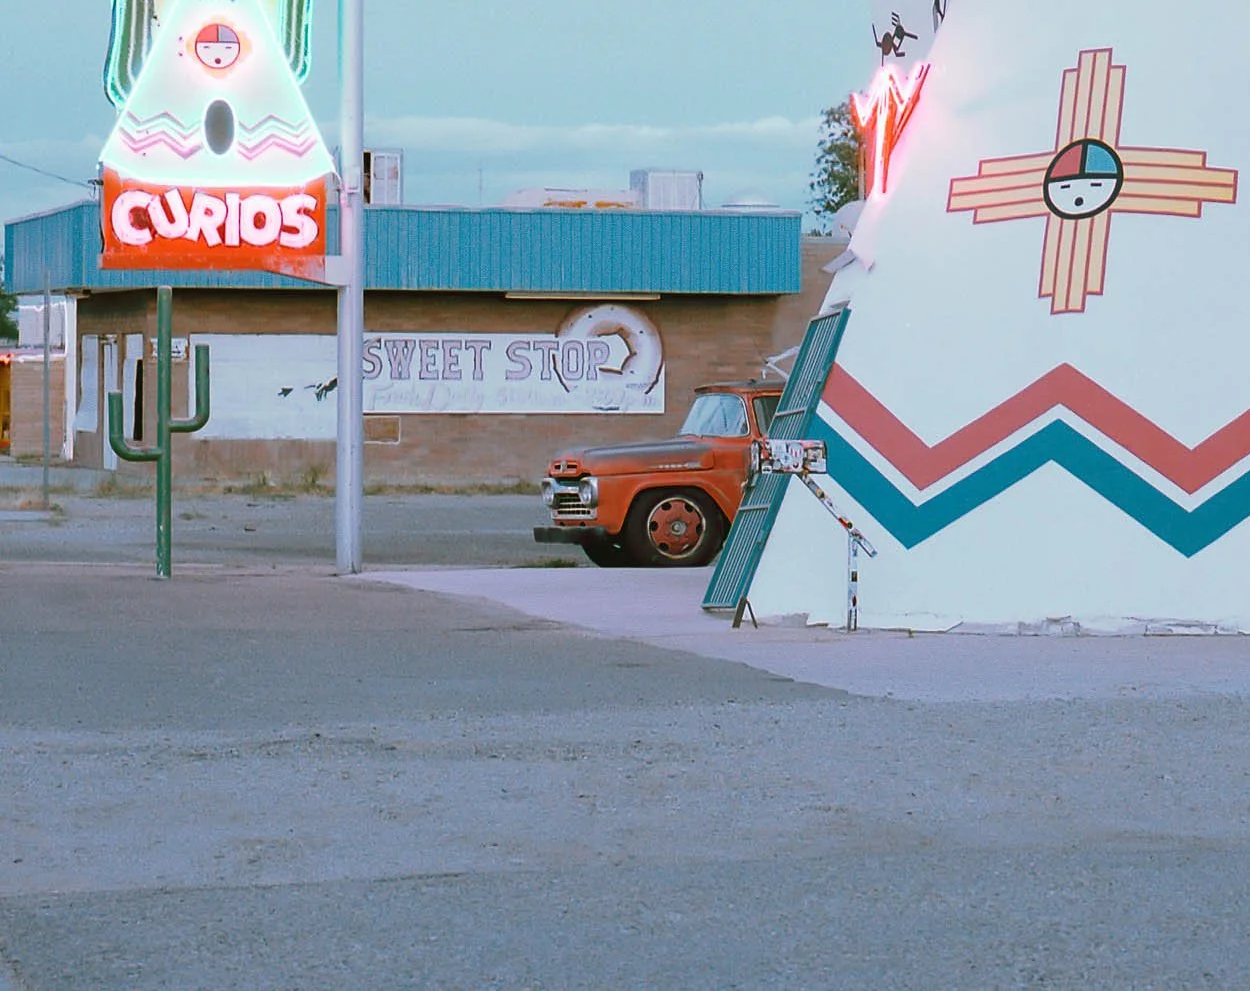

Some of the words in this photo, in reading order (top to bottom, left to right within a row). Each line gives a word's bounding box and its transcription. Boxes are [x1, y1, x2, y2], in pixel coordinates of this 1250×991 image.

[111, 188, 319, 248] CURIOS
[363, 338, 492, 381] SWEET
[505, 340, 610, 381] STOP
